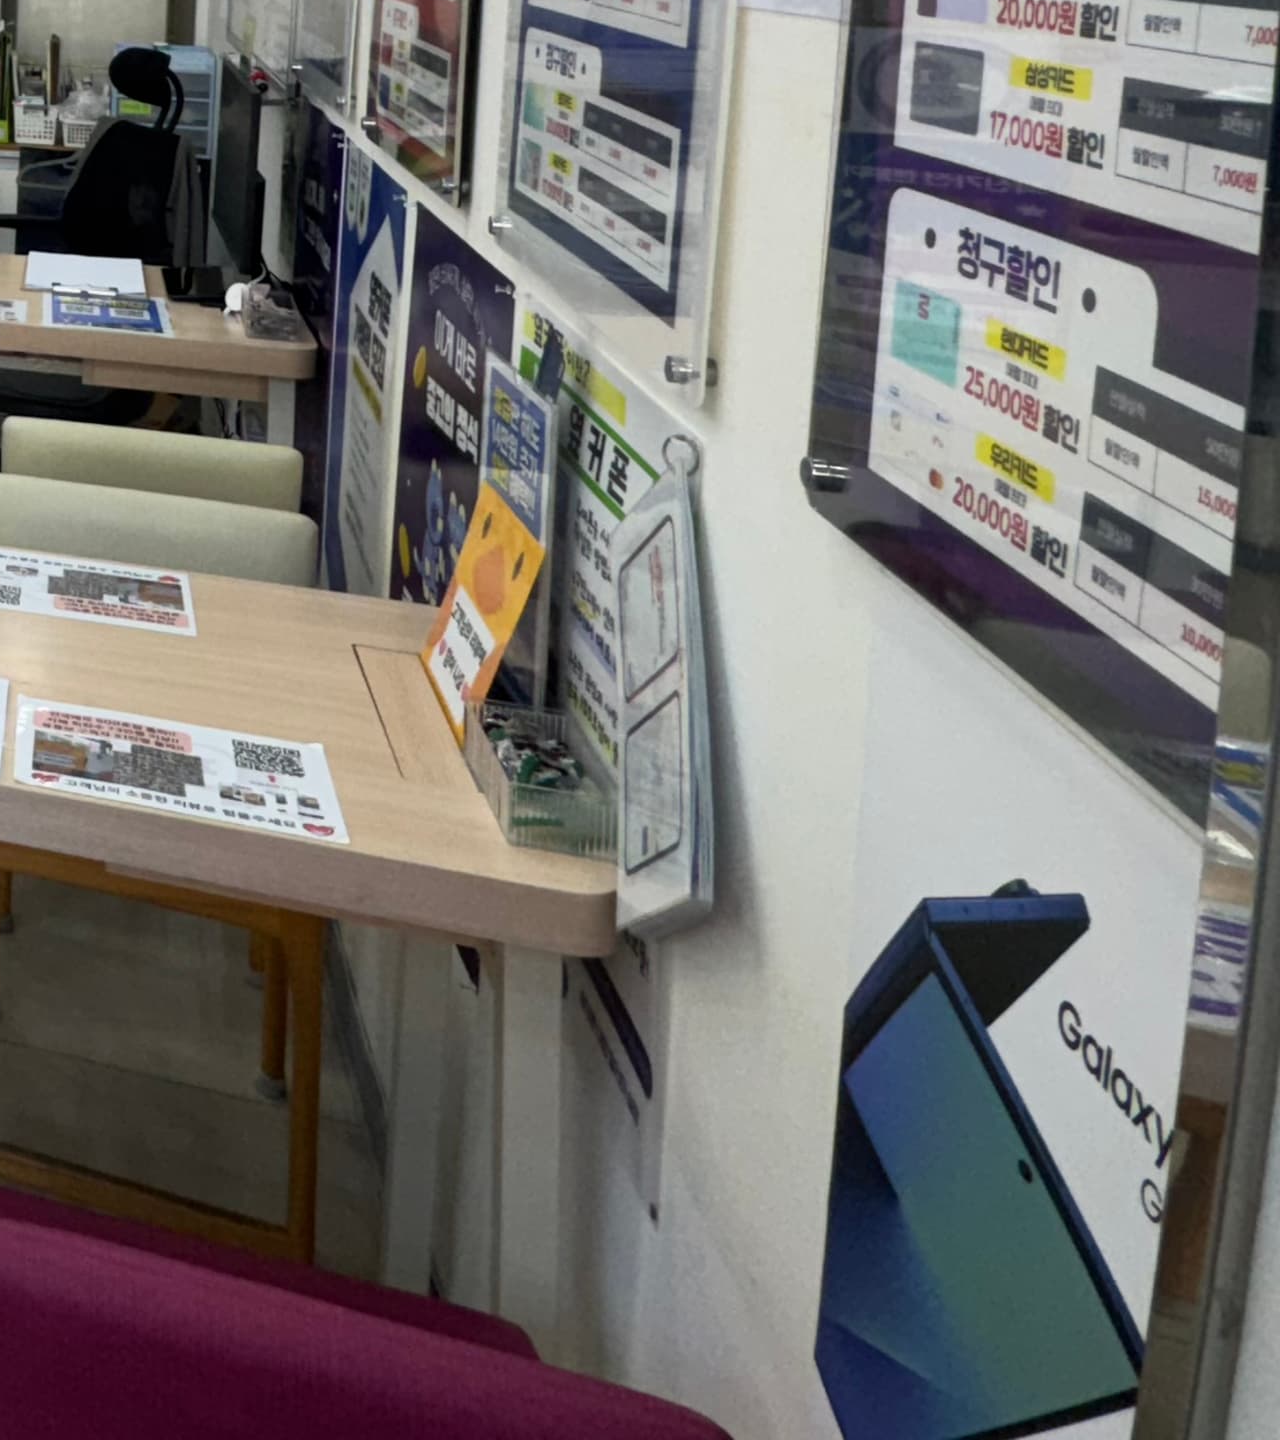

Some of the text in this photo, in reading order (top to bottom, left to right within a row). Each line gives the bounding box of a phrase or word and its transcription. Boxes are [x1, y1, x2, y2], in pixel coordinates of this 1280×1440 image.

[1080, 2, 1120, 42] 할인
[1025, 63, 1075, 93] 삼성카드
[990, 111, 1105, 170] 17,000원 할인
[957, 227, 1061, 314] 청구할인
[963, 365, 1080, 456] 25,000원 할인
[952, 476, 1070, 579] 20,000원 할인
[1058, 1000, 1176, 1168] Galaxy
